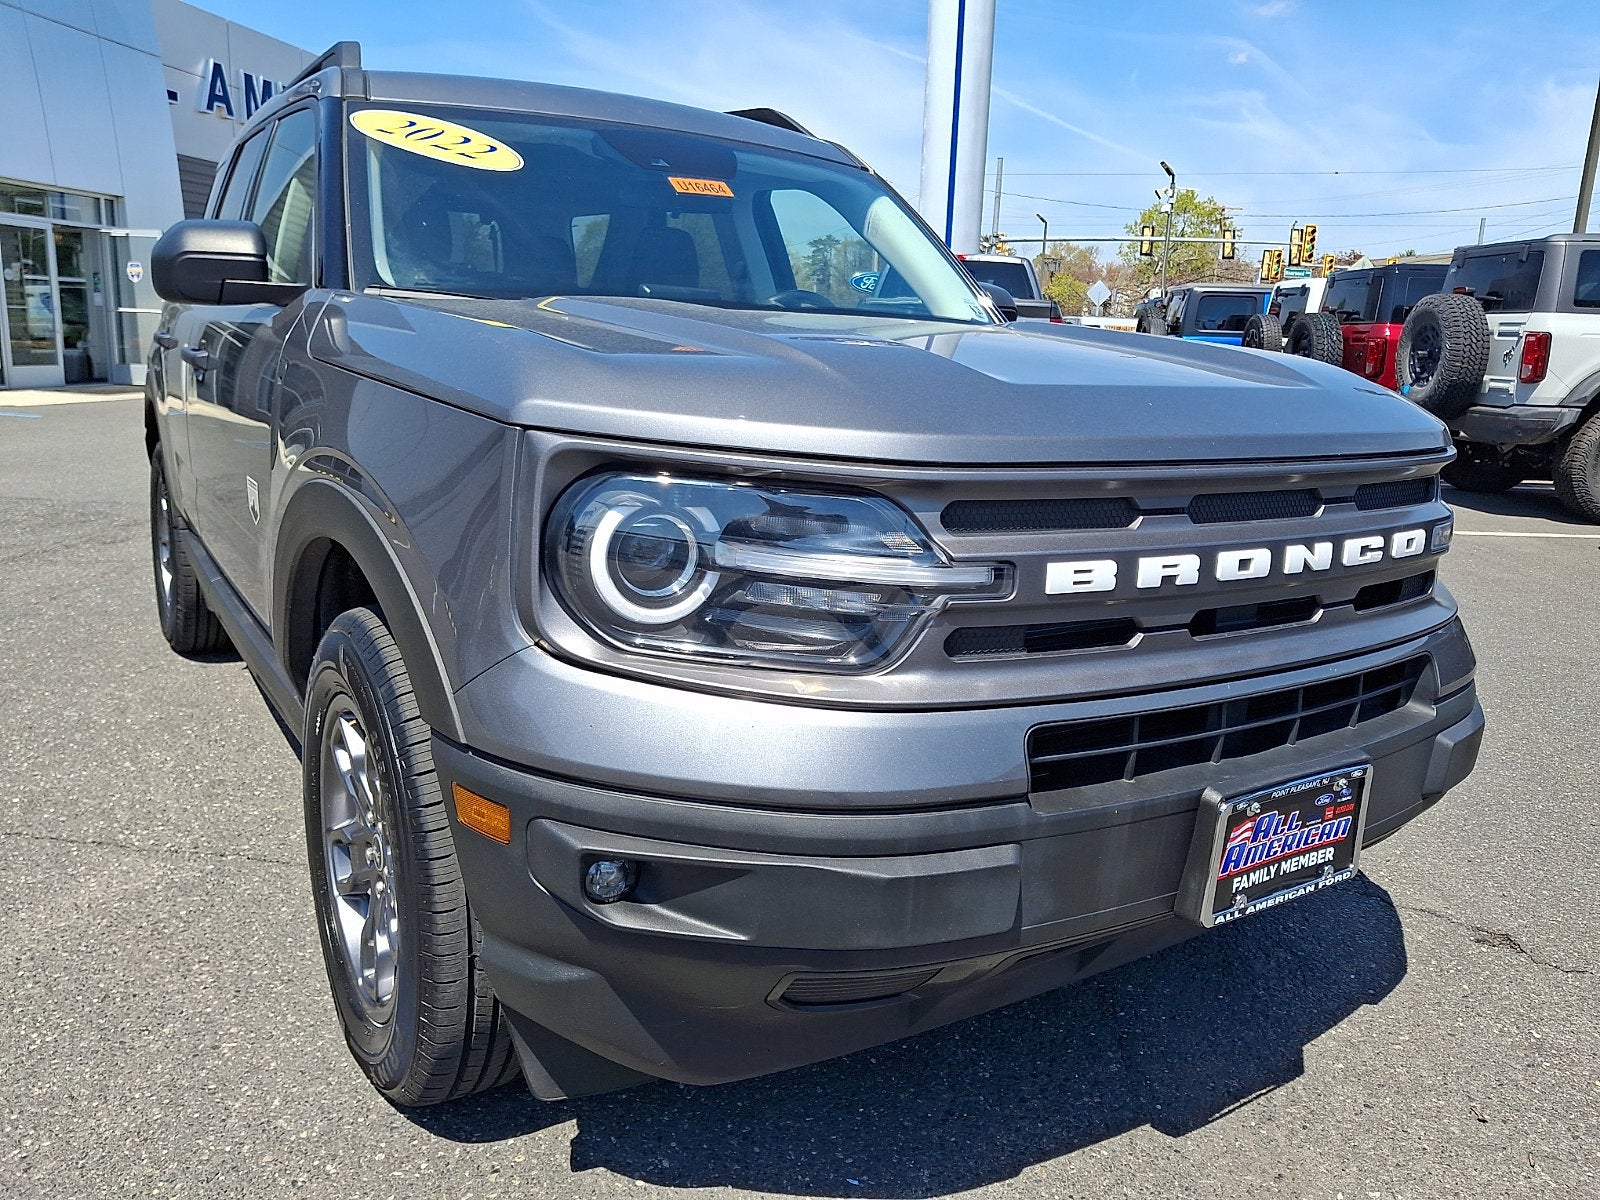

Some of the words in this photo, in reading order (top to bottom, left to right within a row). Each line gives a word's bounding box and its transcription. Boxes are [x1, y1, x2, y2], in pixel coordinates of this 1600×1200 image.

[200, 59, 286, 120] AM
[375, 120, 497, 160] 2022
[676, 180, 727, 195] U16464
[1045, 529, 1426, 595] BRONCO
[1271, 787, 1291, 799] POINT
[1232, 862, 1279, 894] FAMILY
[1280, 846, 1335, 876] MEMBER
[1214, 910, 1243, 925] ALL
[1245, 884, 1316, 915] AMERICAN
[1318, 871, 1352, 889] FORD
